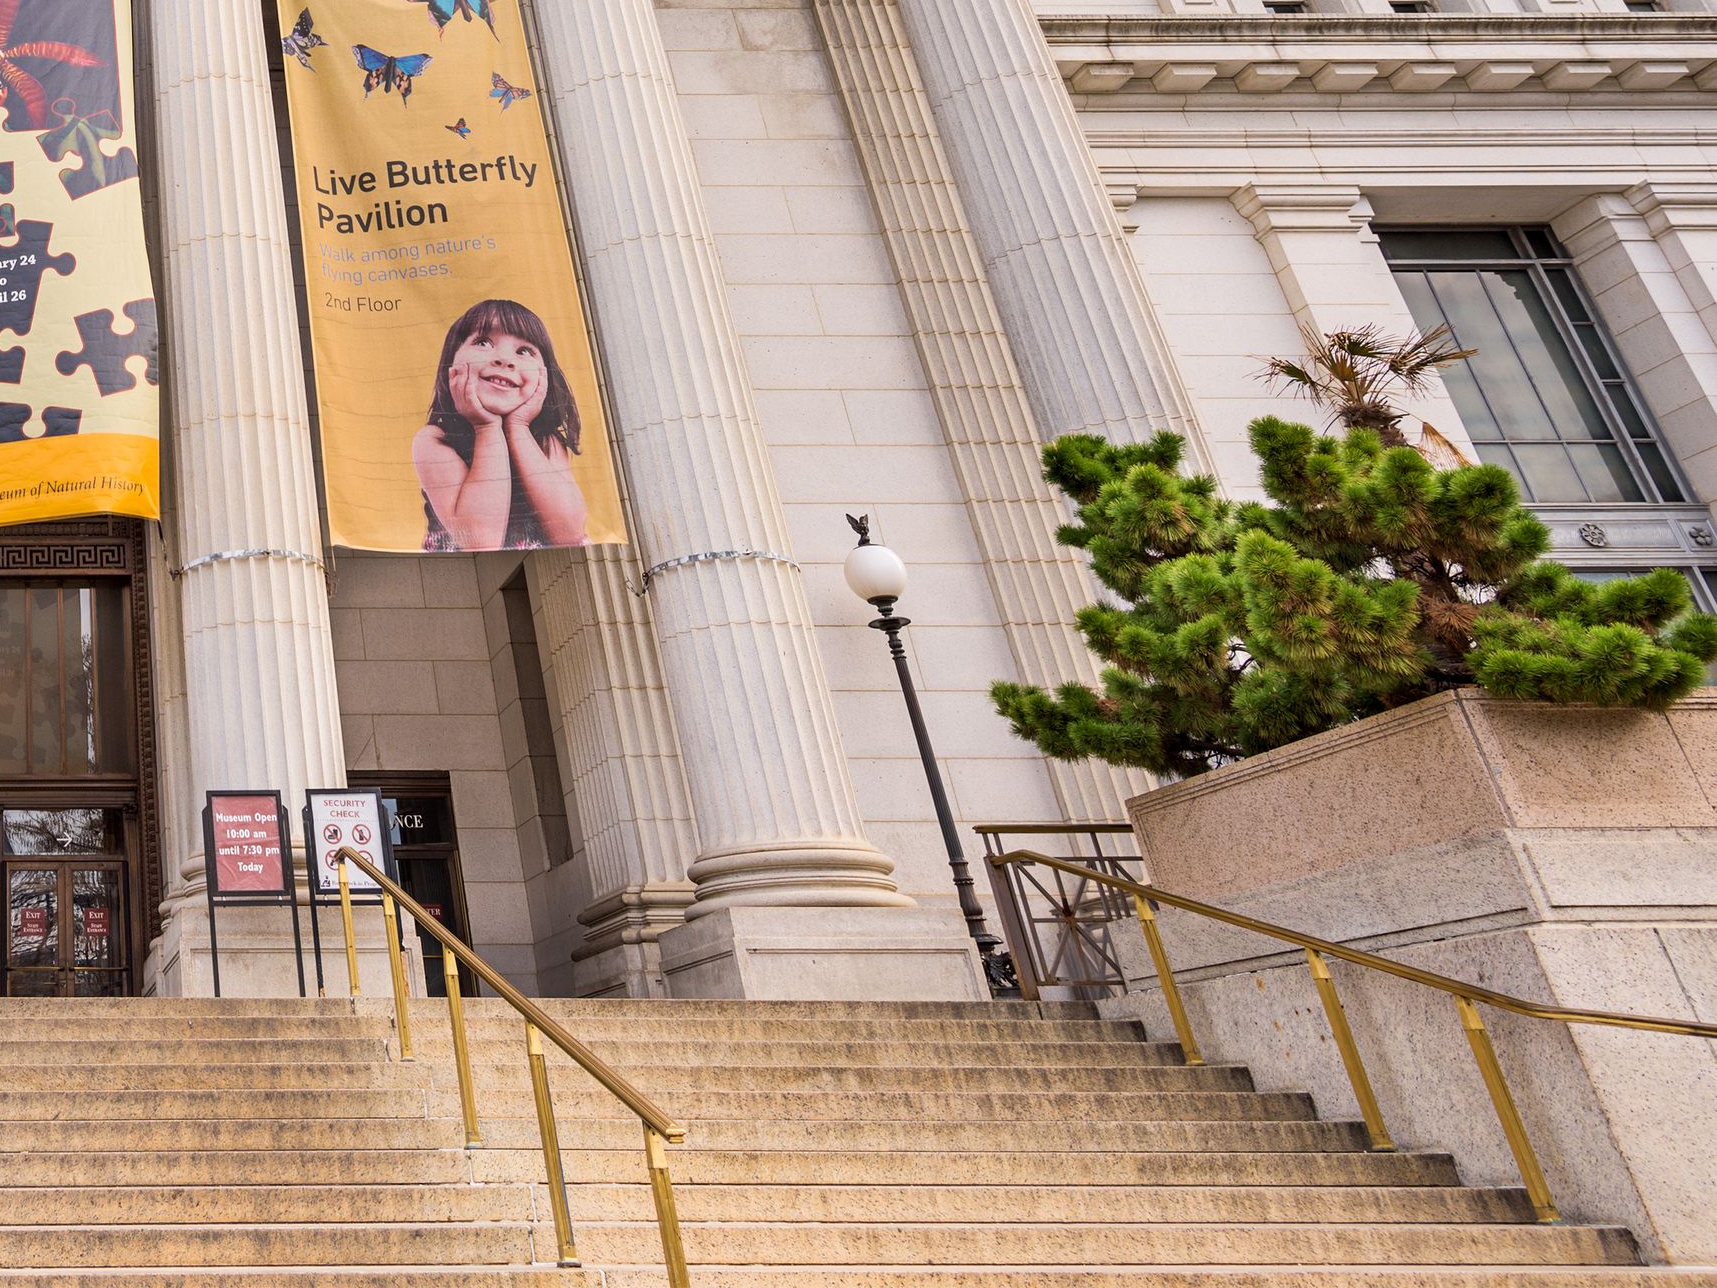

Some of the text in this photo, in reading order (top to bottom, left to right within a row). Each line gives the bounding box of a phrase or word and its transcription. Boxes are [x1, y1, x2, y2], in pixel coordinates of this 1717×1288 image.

[312, 155, 537, 196] Live Butterfly
[317, 199, 449, 234] Pavilion
[318, 235, 497, 263] Walk among nature's
[19, 254, 36, 266] 24
[321, 262, 453, 286] flying canvases.
[10, 289, 26, 302] 26
[324, 292, 402, 312] 2nd Floor
[30, 480, 44, 500] of
[45, 476, 97, 495] Natural
[101, 476, 145, 497] History
[323, 799, 366, 808] SECURITY
[216, 811, 277, 824] Museum Open
[330, 809, 360, 819] CHECK
[226, 829, 267, 839] 10:00 am
[218, 845, 280, 857] until 7:30 pm
[237, 861, 264, 874] Today
[25, 911, 41, 919] EXIT
[89, 911, 104, 919] EXIT
